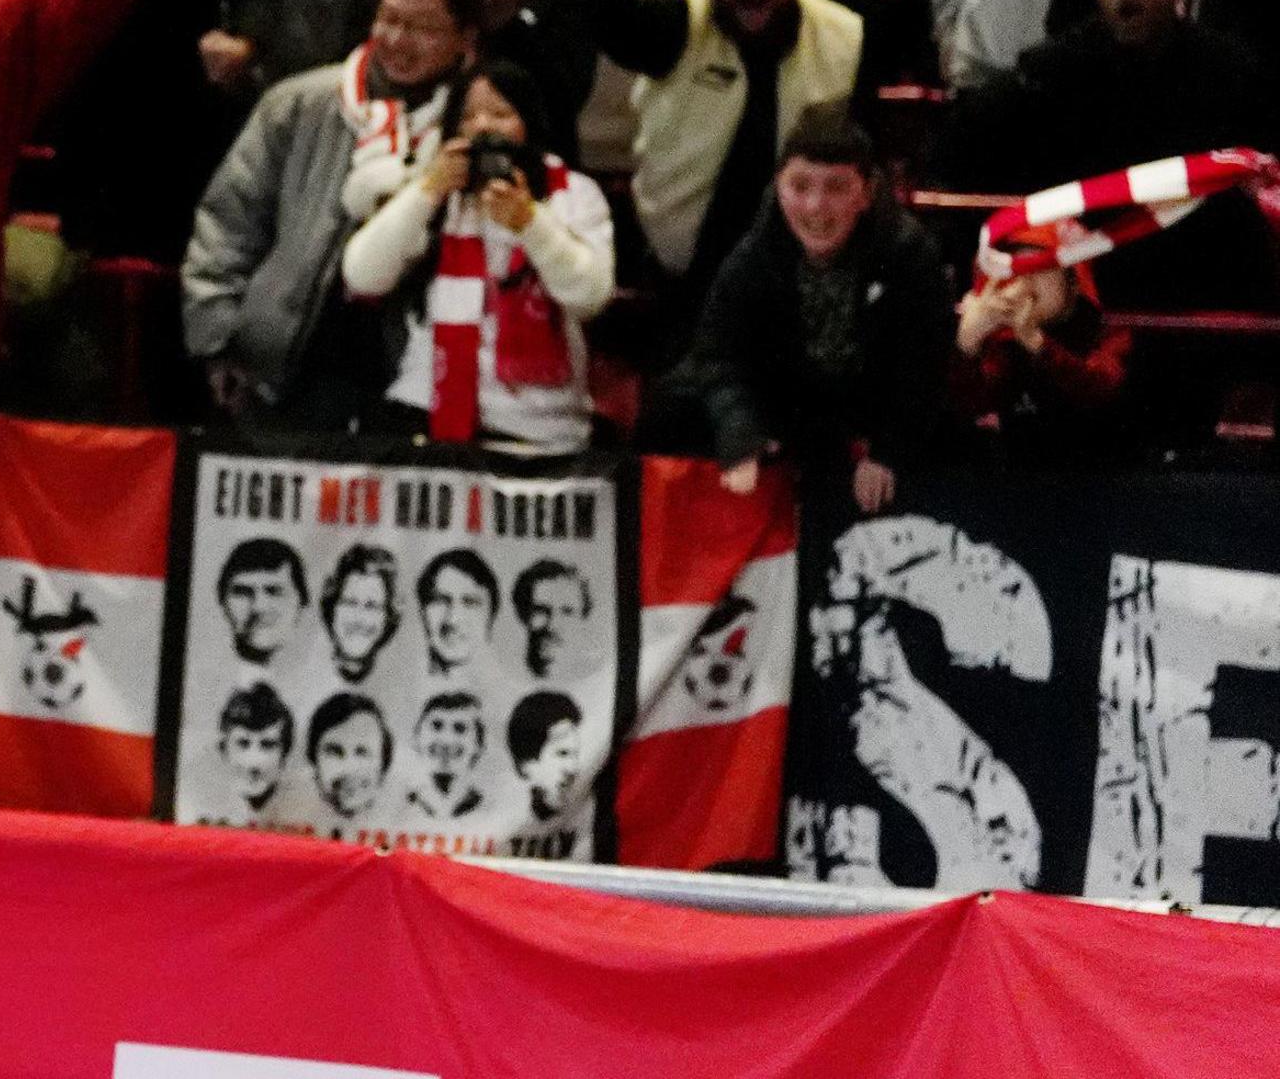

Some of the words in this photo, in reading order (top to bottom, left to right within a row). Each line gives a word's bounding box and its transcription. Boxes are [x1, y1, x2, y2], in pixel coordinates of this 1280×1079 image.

[215, 469, 304, 524] EIGHT
[319, 476, 381, 526] MEN
[395, 481, 453, 530] HAD
[466, 483, 482, 535] A
[495, 490, 595, 540] DREAM
